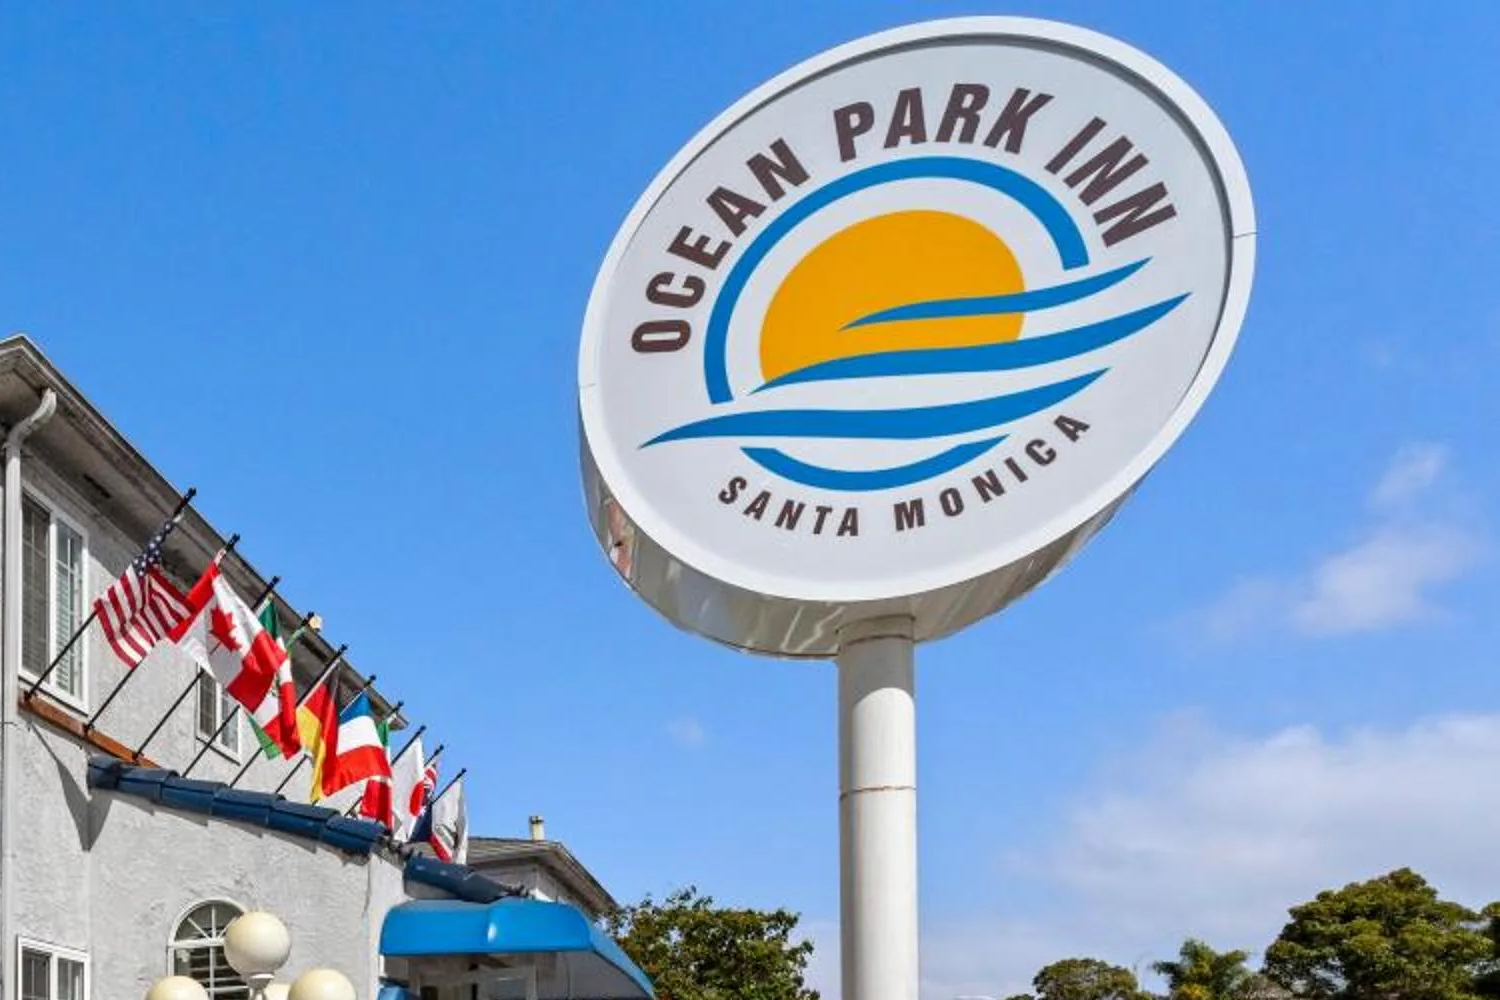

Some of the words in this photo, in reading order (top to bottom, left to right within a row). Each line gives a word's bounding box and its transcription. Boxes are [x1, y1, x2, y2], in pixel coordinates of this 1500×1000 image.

[630, 137, 812, 354] OCEAN
[833, 82, 1055, 163] PARK
[1044, 116, 1177, 248] INN
[718, 476, 859, 537] SANTA
[893, 414, 1091, 532] MONICA
